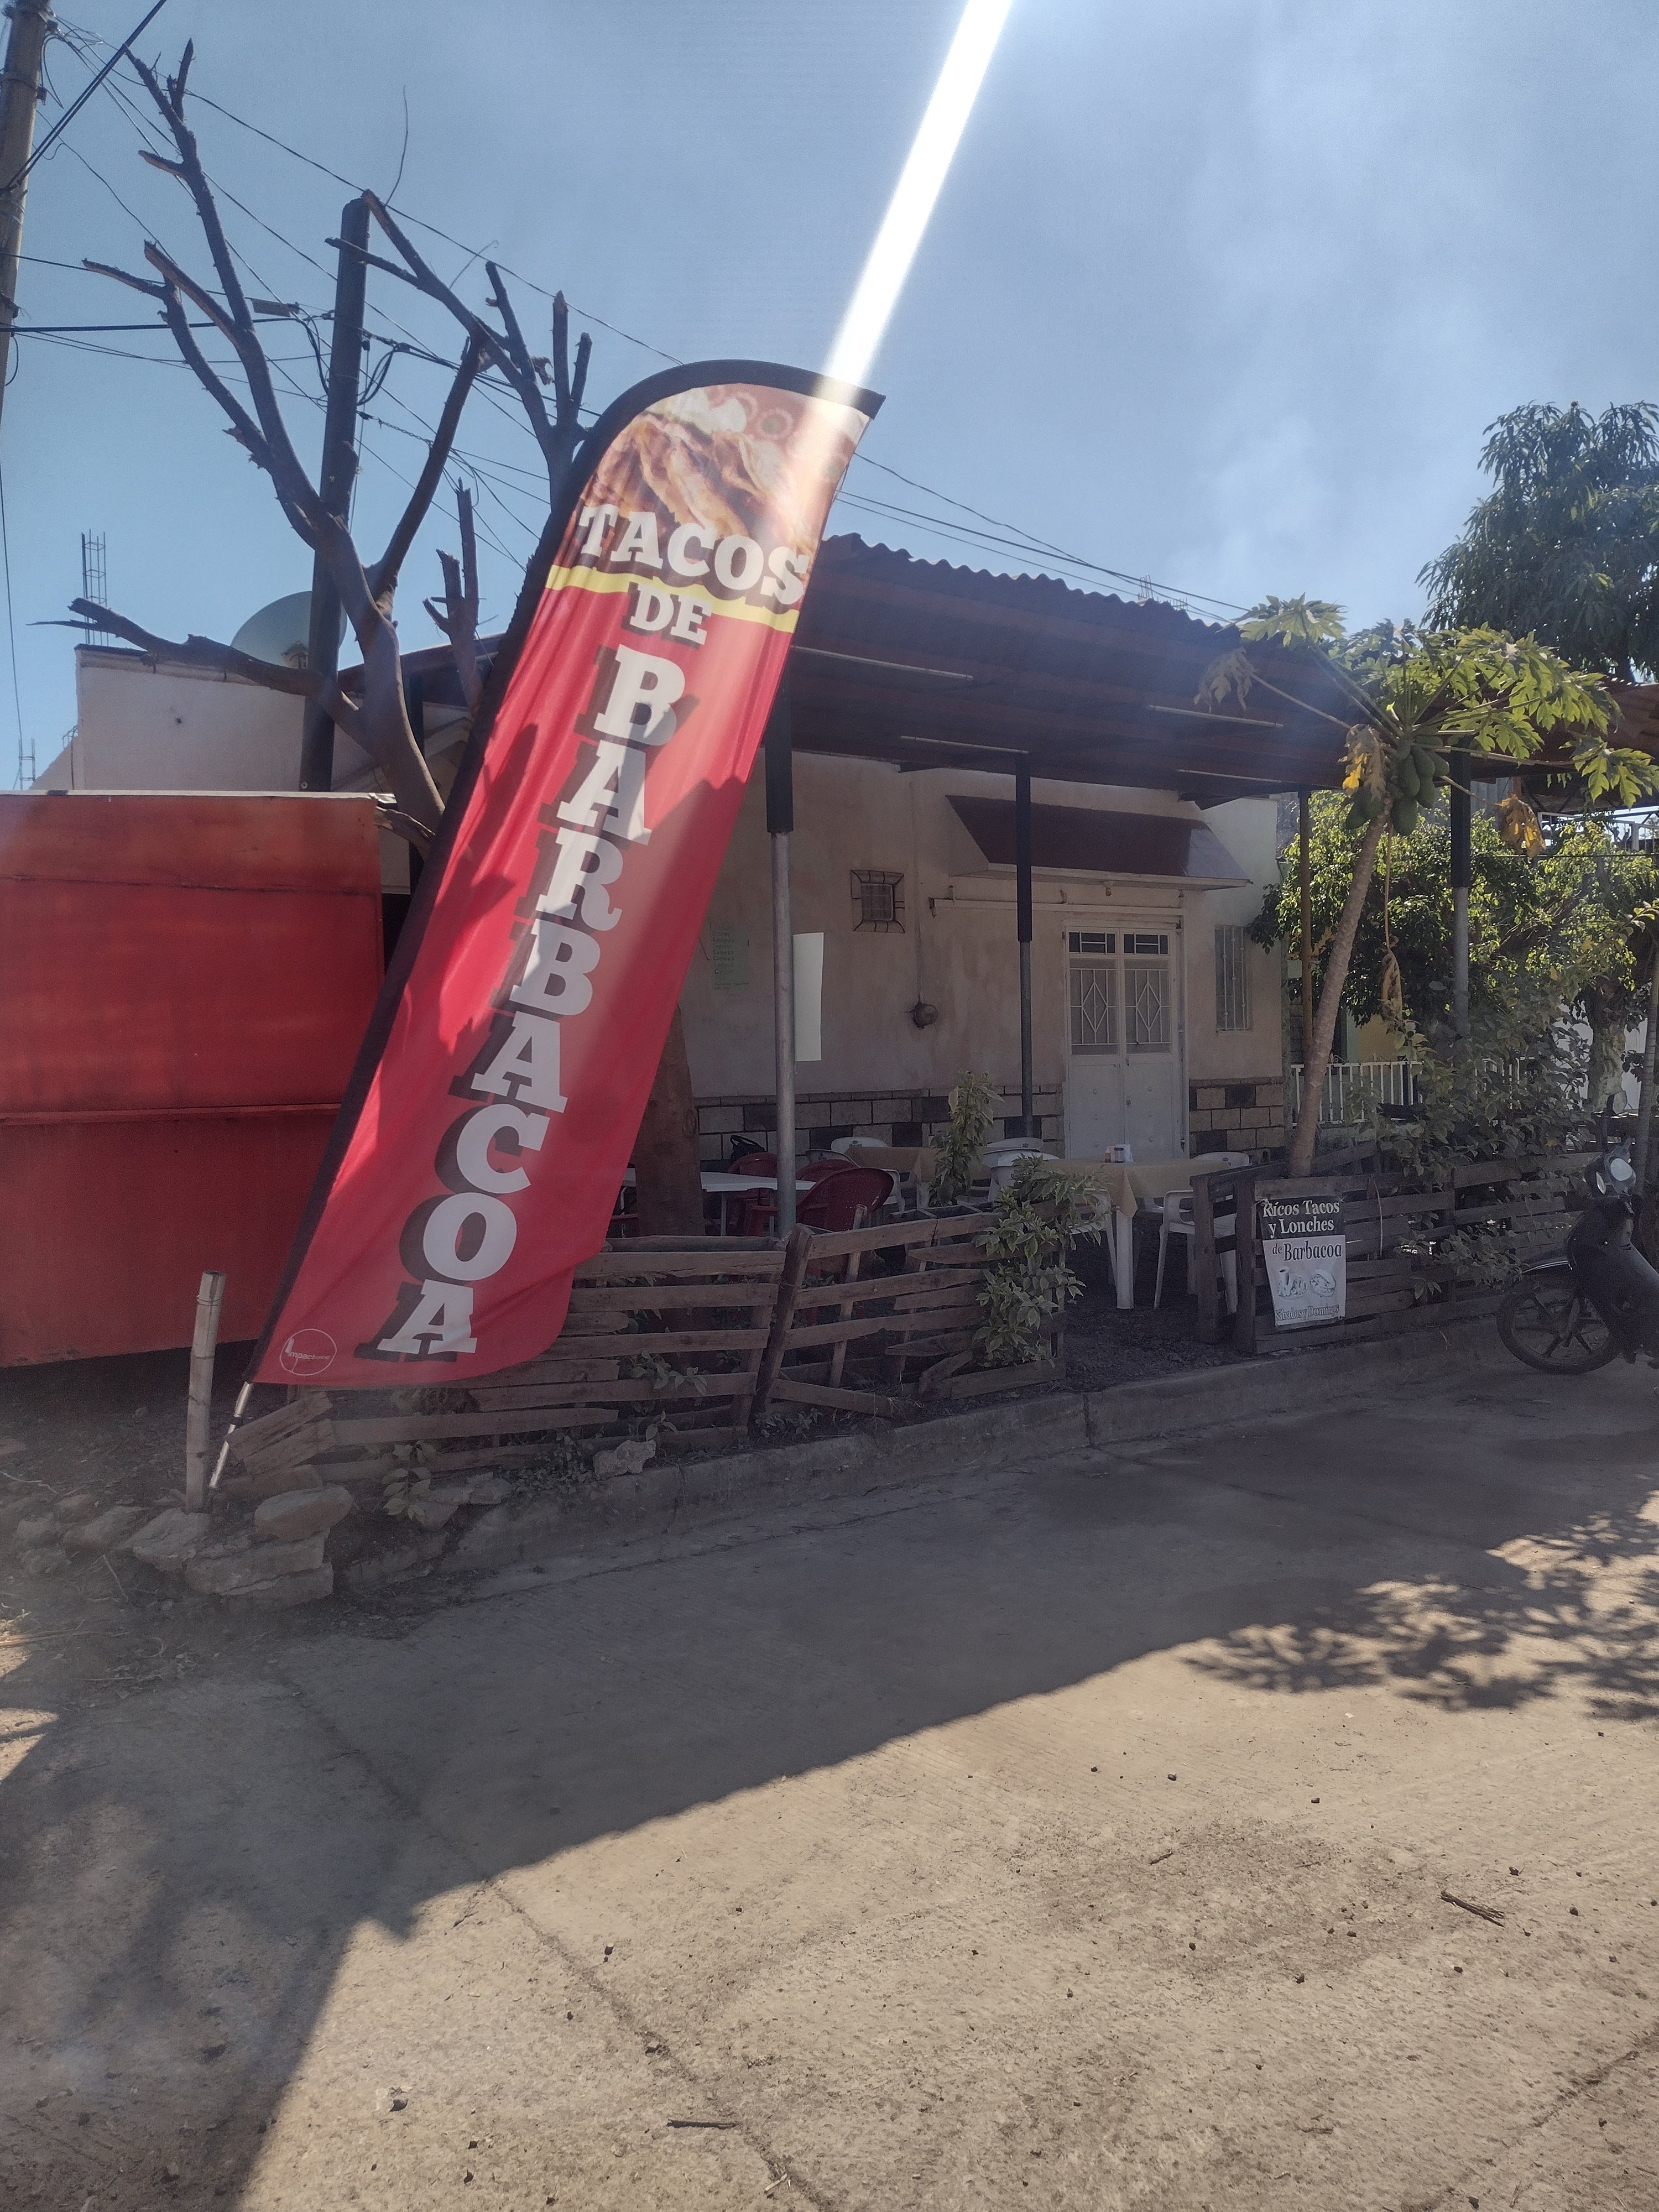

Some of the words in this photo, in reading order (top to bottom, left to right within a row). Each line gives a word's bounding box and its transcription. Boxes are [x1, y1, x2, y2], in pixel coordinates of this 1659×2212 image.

[578, 503, 811, 606] TACOS
[629, 582, 712, 645] DE
[378, 644, 686, 1354] BARBACOA
[1269, 1223, 1276, 1239] y
[1279, 1216, 1334, 1234] Lonches
[1302, 1200, 1340, 1214] Tacos
[1272, 1243, 1282, 1254] de
[1284, 1240, 1342, 1261] Barbacoa
